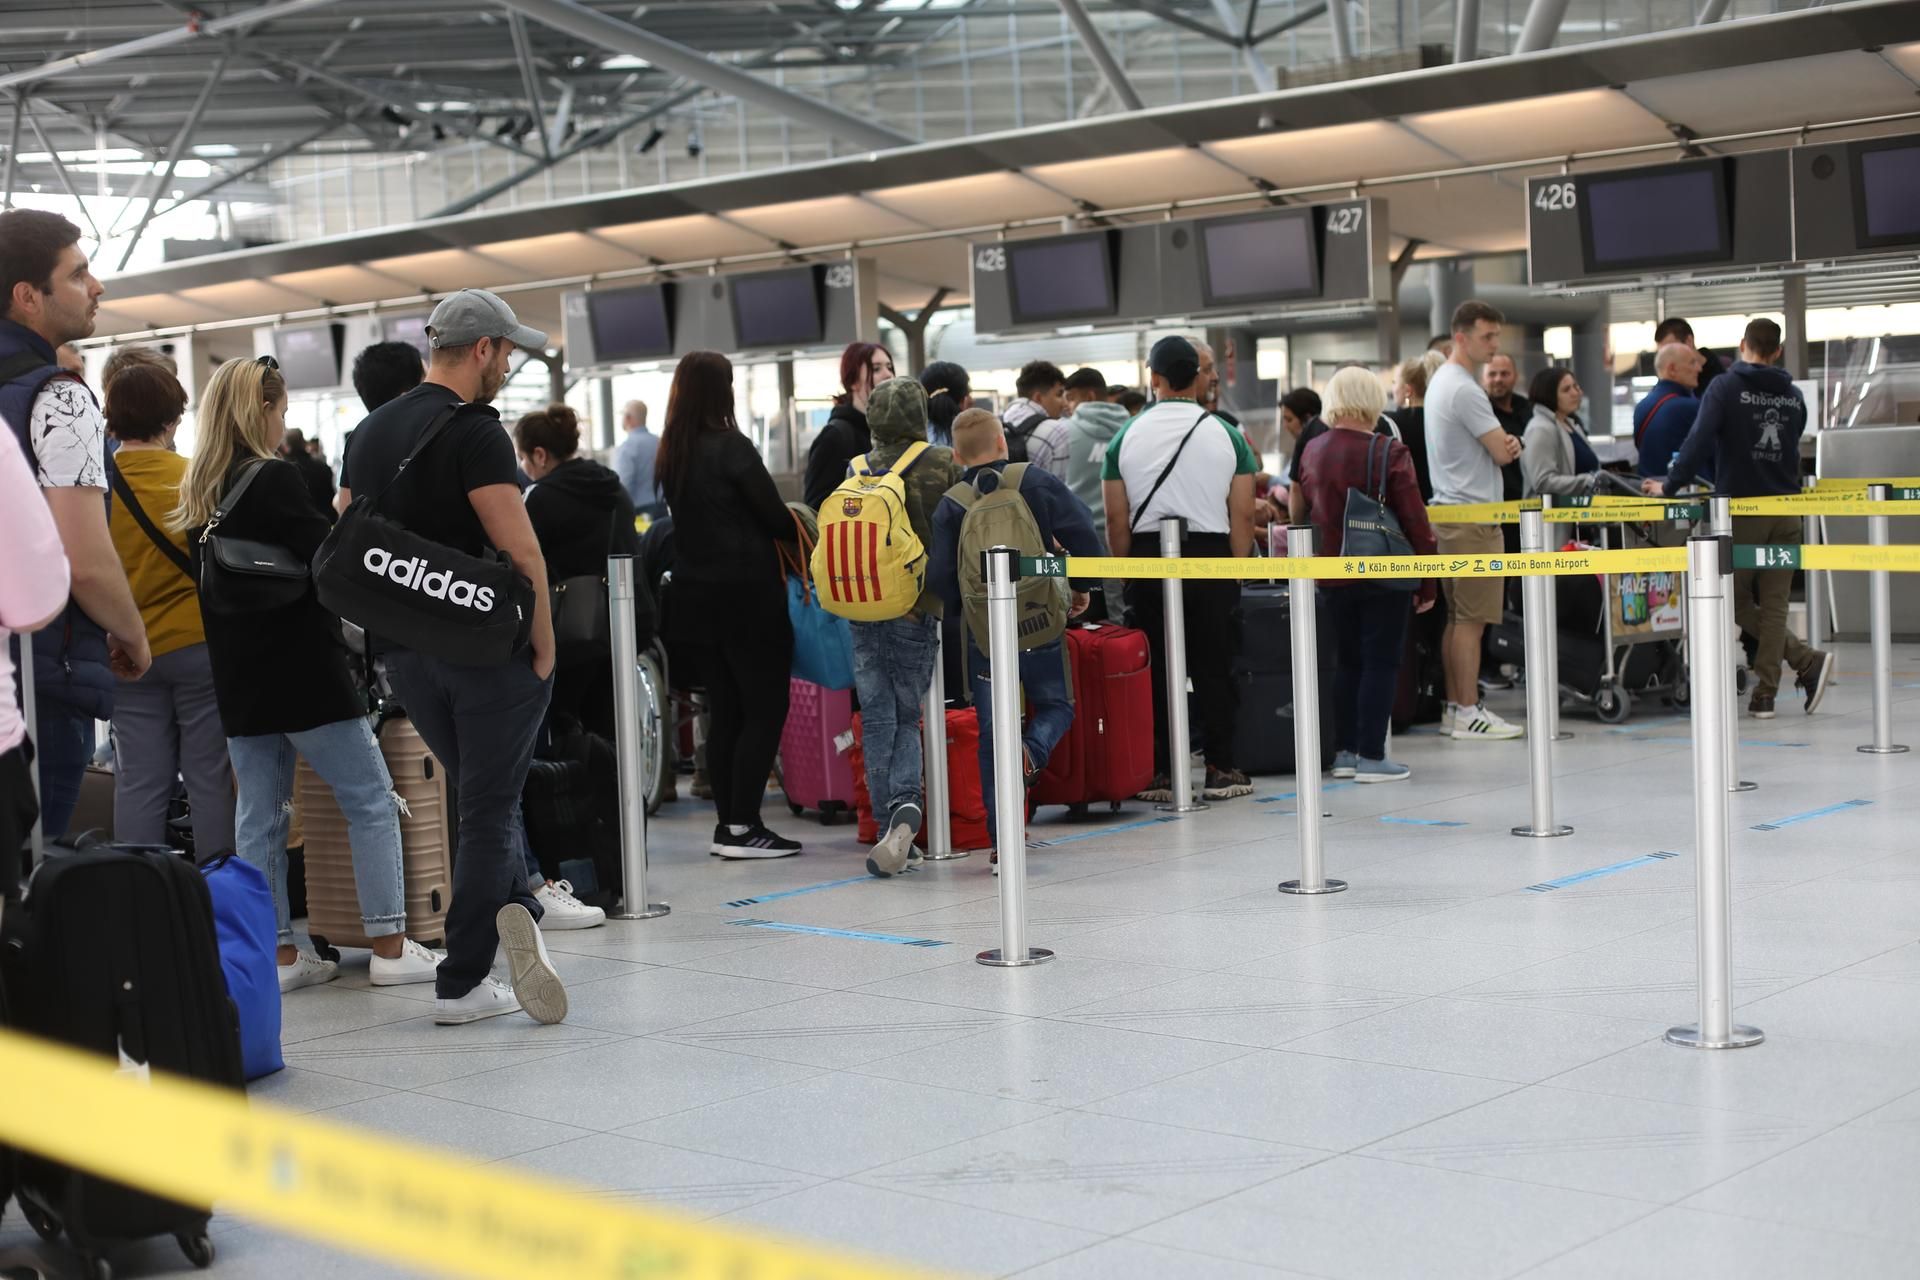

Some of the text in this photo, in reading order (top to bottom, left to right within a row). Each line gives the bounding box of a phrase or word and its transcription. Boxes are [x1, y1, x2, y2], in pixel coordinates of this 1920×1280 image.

[1535, 182, 1576, 211] 426
[1326, 207, 1362, 235] 427
[1369, 561, 1445, 574] Köln Bonn Airport
[1507, 558, 1590, 571] Köln Bonn Airport
[363, 548, 495, 612] adidas
[1616, 573, 1676, 595] HAVE FUN!
